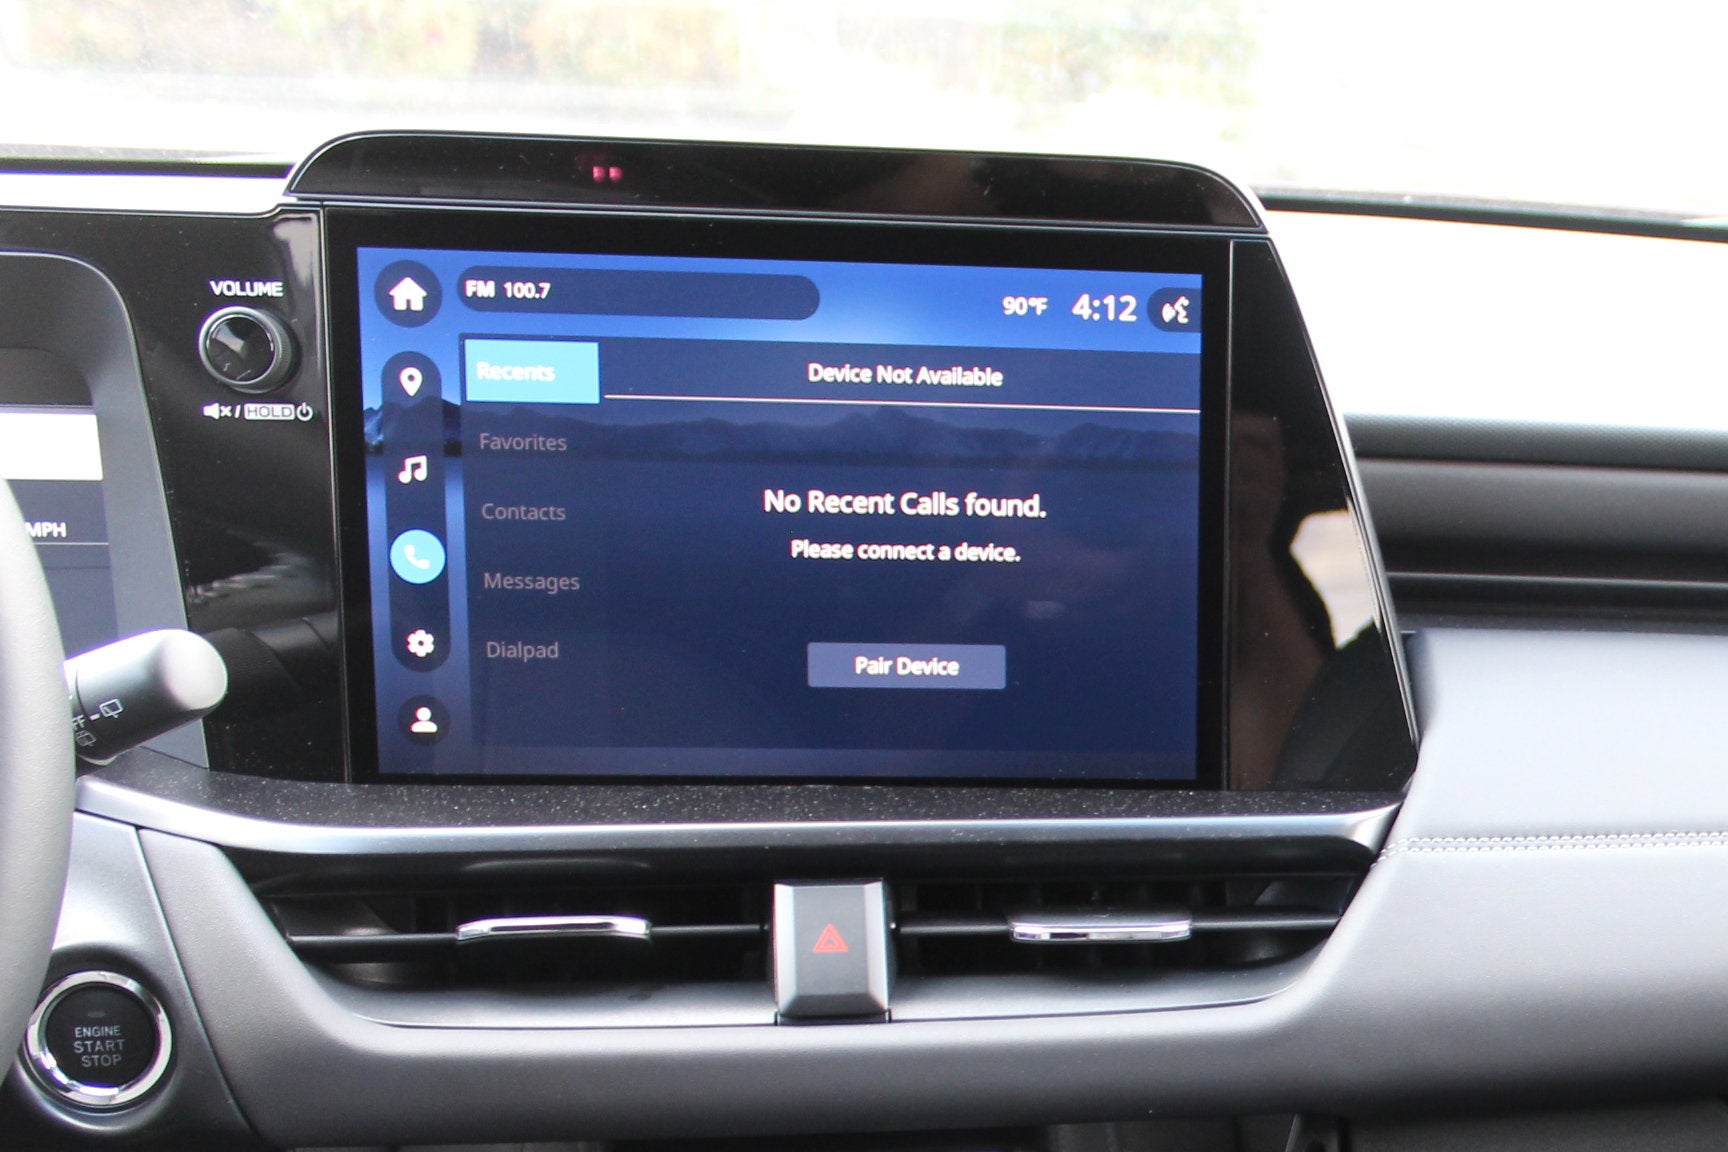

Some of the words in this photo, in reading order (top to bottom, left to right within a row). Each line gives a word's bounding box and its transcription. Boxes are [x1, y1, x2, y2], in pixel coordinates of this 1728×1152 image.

[210, 280, 284, 297] VOLUME
[465, 280, 496, 298] FM
[503, 281, 552, 300] 100.7
[1071, 293, 1138, 322] 4:12
[476, 361, 556, 382] Recents
[807, 362, 873, 385] Device
[876, 364, 914, 385] Not
[916, 365, 1004, 388] Available
[246, 406, 294, 419] HOLD
[479, 433, 568, 451] Favorites
[481, 503, 567, 521] Contacts
[764, 489, 802, 513] No
[807, 490, 895, 514] Recent
[899, 492, 961, 516] Calls
[964, 492, 1048, 519] found.
[26, 522, 68, 538] MPH
[790, 539, 854, 560] Please
[857, 543, 935, 561] connect
[937, 545, 951, 562] a
[953, 541, 1021, 563] device.
[484, 572, 581, 595] Messages
[487, 641, 560, 663] Dialpad
[854, 656, 894, 676] Pair
[896, 656, 961, 677] Device
[75, 1025, 122, 1038] ENGINE
[73, 1039, 126, 1054] START
[81, 1054, 122, 1068] STOP
